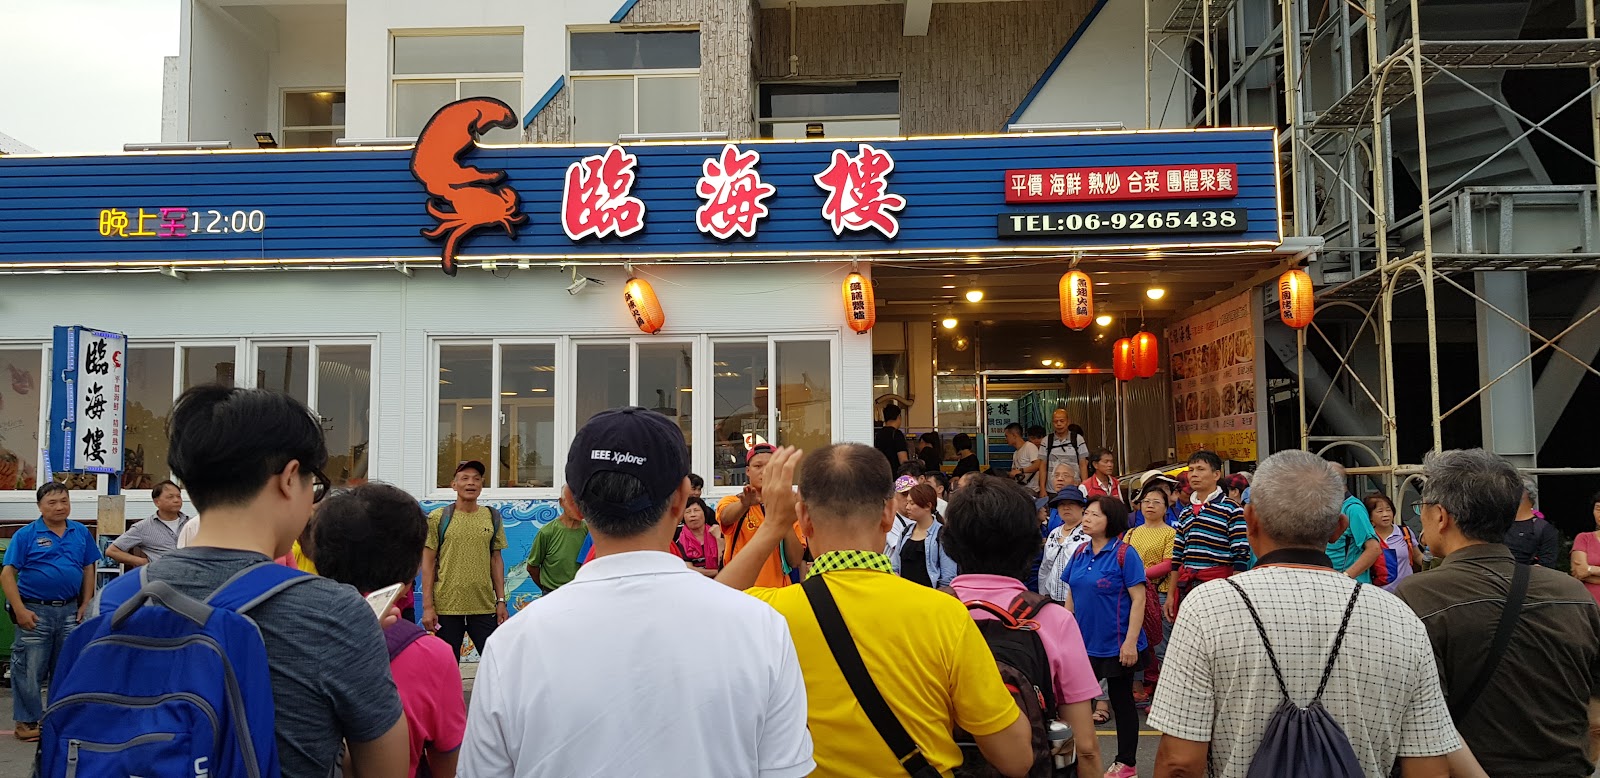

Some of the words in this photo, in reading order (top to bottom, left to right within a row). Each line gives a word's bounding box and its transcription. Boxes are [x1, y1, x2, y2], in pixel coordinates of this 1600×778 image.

[562, 143, 906, 240] 臨海樓
[1011, 173, 1043, 198] 平價
[1049, 171, 1082, 196] 海鮮
[1087, 170, 1121, 195] 熱炒
[1127, 169, 1160, 194] 合菜
[1166, 167, 1233, 193] 團體聚餐
[1009, 210, 1237, 232] TEL:06-9265438
[82, 338, 109, 465] 臨海樓
[590, 449, 611, 460] IEEE
